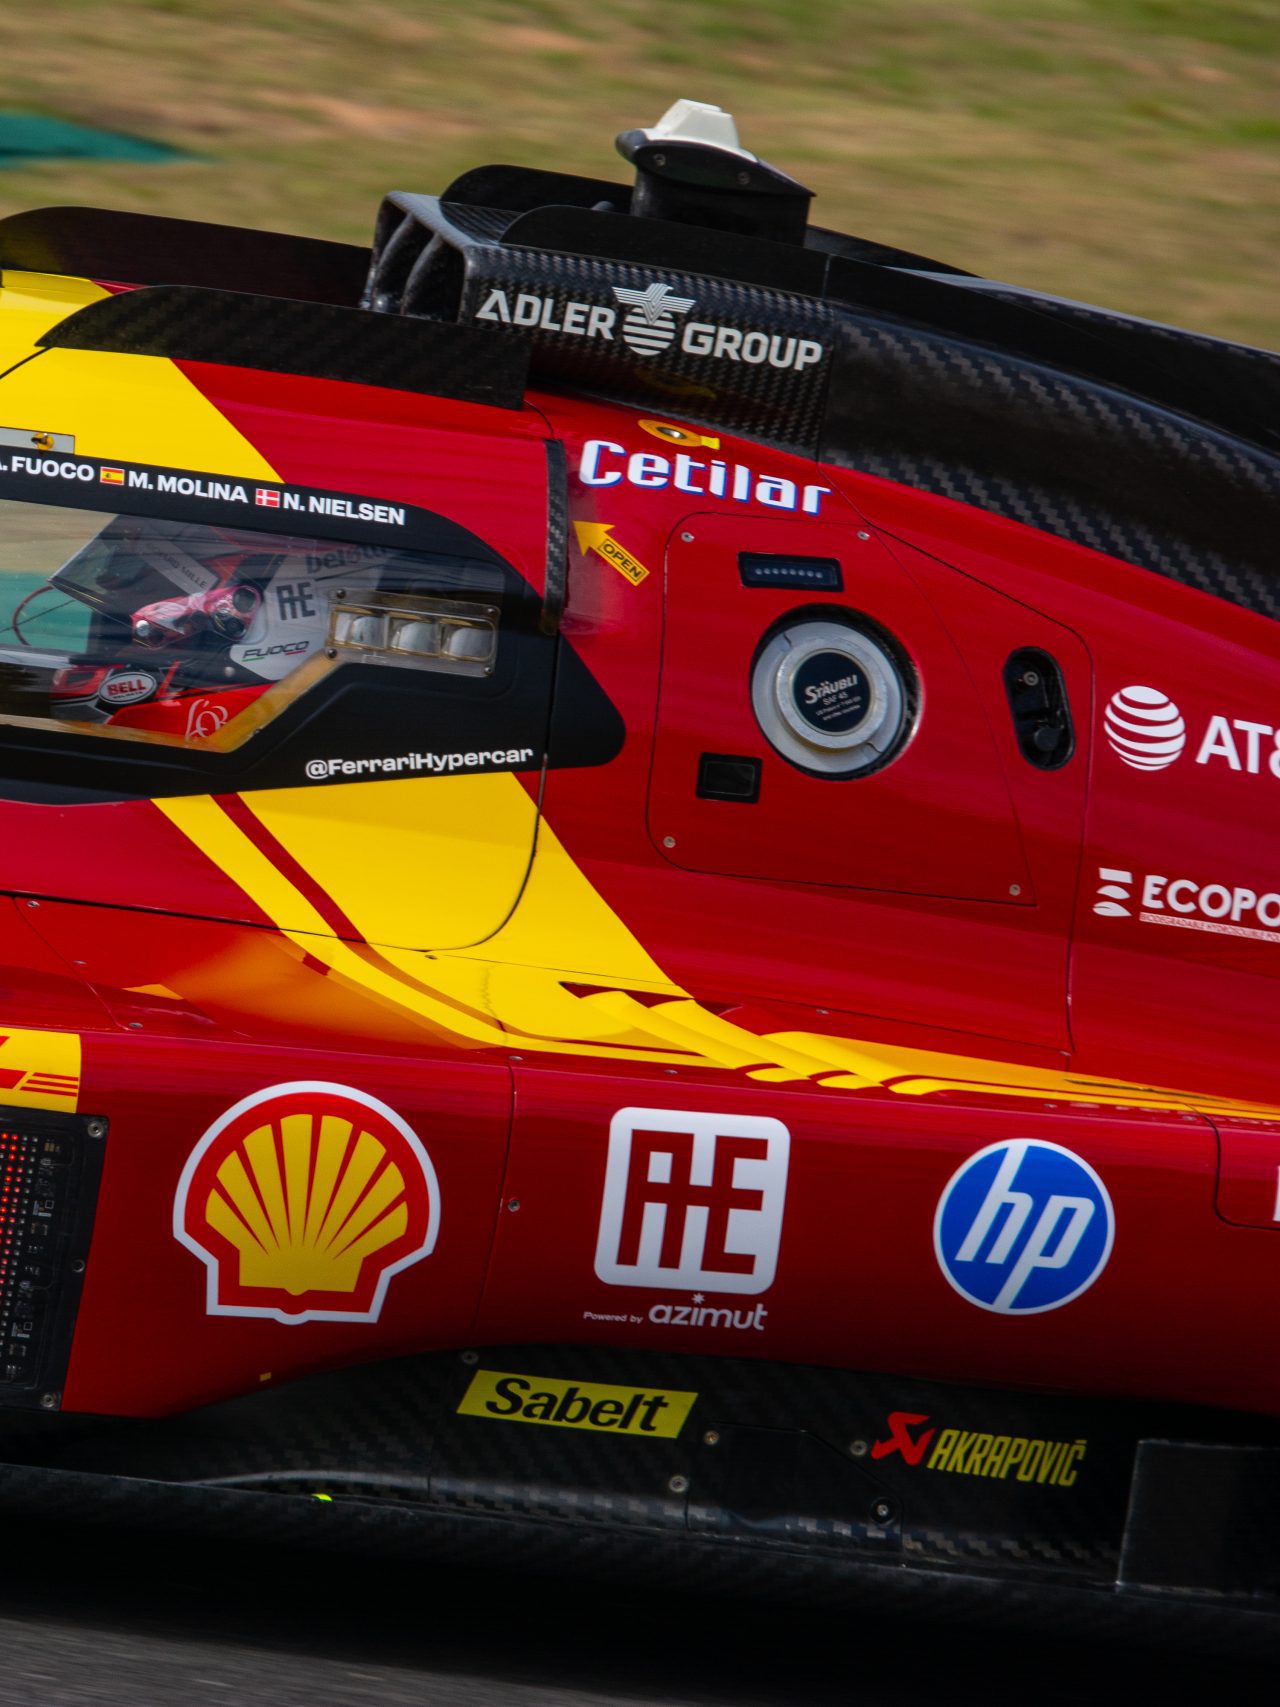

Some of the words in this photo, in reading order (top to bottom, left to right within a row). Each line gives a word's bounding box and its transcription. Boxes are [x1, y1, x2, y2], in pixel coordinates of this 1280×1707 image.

[475, 288, 616, 341] ADLER
[681, 321, 823, 372] GROUP
[11, 455, 95, 483] FUOCO
[578, 439, 833, 516] Cetilar
[128, 470, 155, 491] M.
[157, 474, 248, 504] MOLINA
[283, 492, 306, 512] N.
[309, 495, 406, 526] NIELSEN
[603, 543, 642, 578] OPEN
[242, 640, 310, 660] FUOCO
[106, 679, 147, 697] BELL
[305, 746, 534, 781] @FerrariHypercar
[1141, 874, 1280, 928] ECOPO
[954, 1144, 1098, 1310] hp
[582, 1311, 628, 1323] Powered
[630, 1313, 644, 1324] by
[648, 1294, 769, 1331] azimut
[485, 1376, 669, 1433] Sabelt
